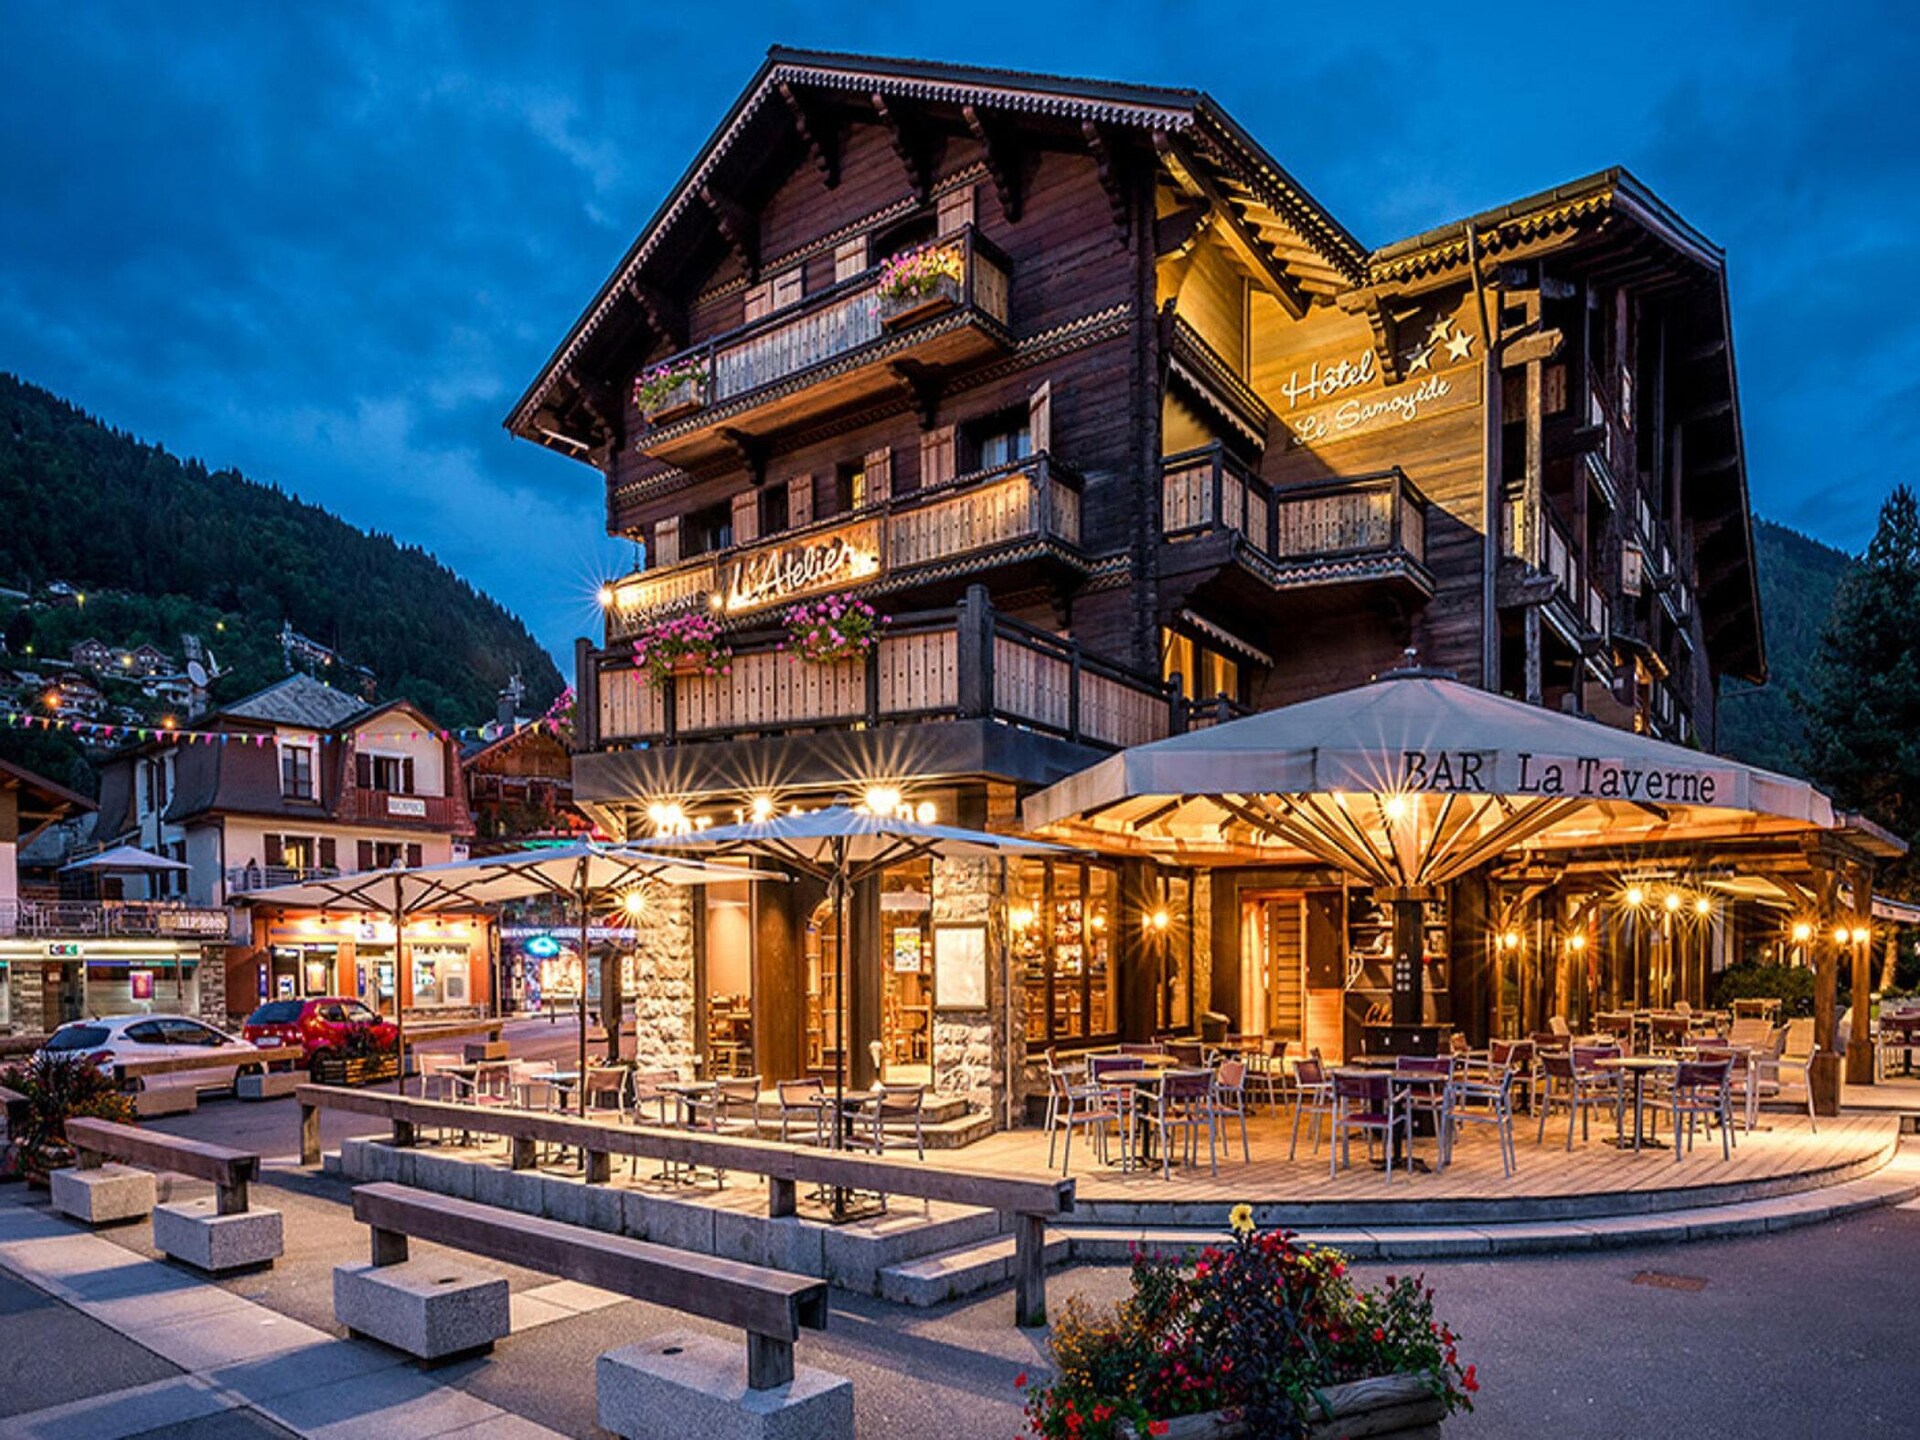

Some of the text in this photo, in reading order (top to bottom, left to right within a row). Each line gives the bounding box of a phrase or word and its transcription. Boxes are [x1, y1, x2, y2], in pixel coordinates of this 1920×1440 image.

[1281, 349, 1375, 408] Hôtel
[1293, 374, 1452, 445] Le Samoyède
[728, 542, 857, 604] L'Atelier
[1403, 750, 1717, 803] BAR La Taverne
